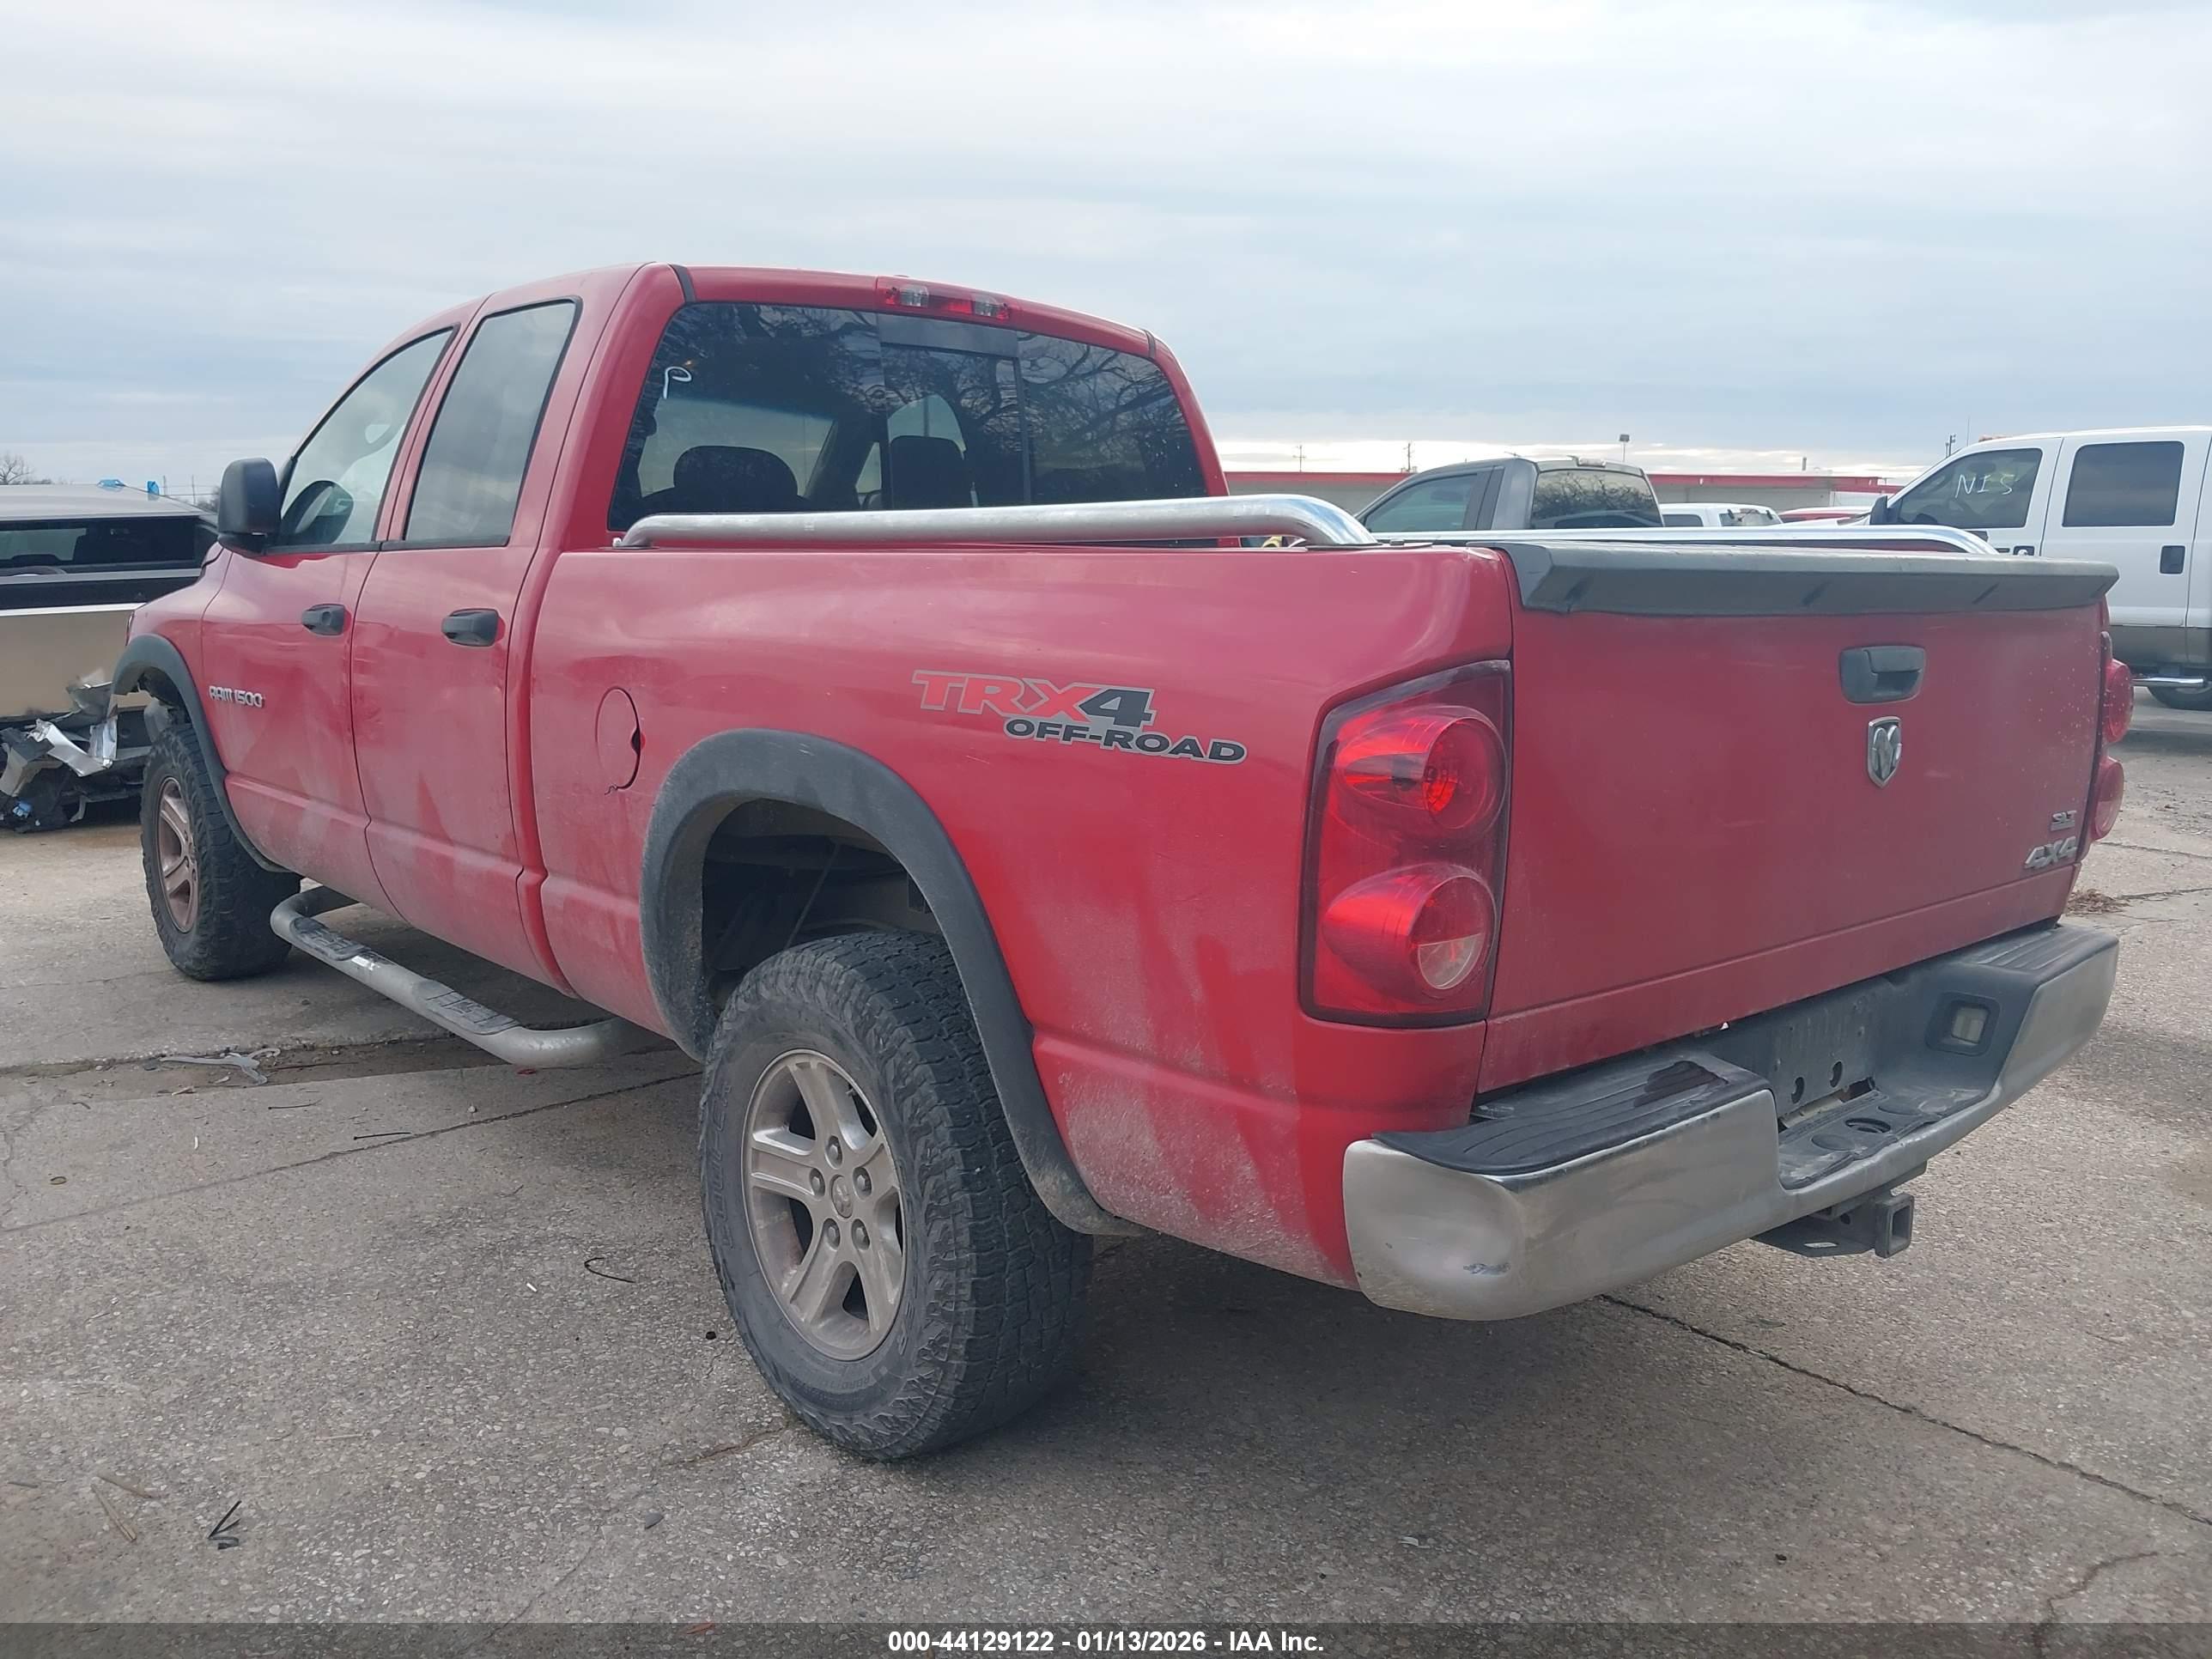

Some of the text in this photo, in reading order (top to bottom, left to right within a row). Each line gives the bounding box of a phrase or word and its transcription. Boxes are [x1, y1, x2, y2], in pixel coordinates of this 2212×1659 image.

[209, 685, 264, 708] RAM 1500
[911, 669, 1157, 728] TRX4
[1005, 717, 1248, 765] OFF-ROAD
